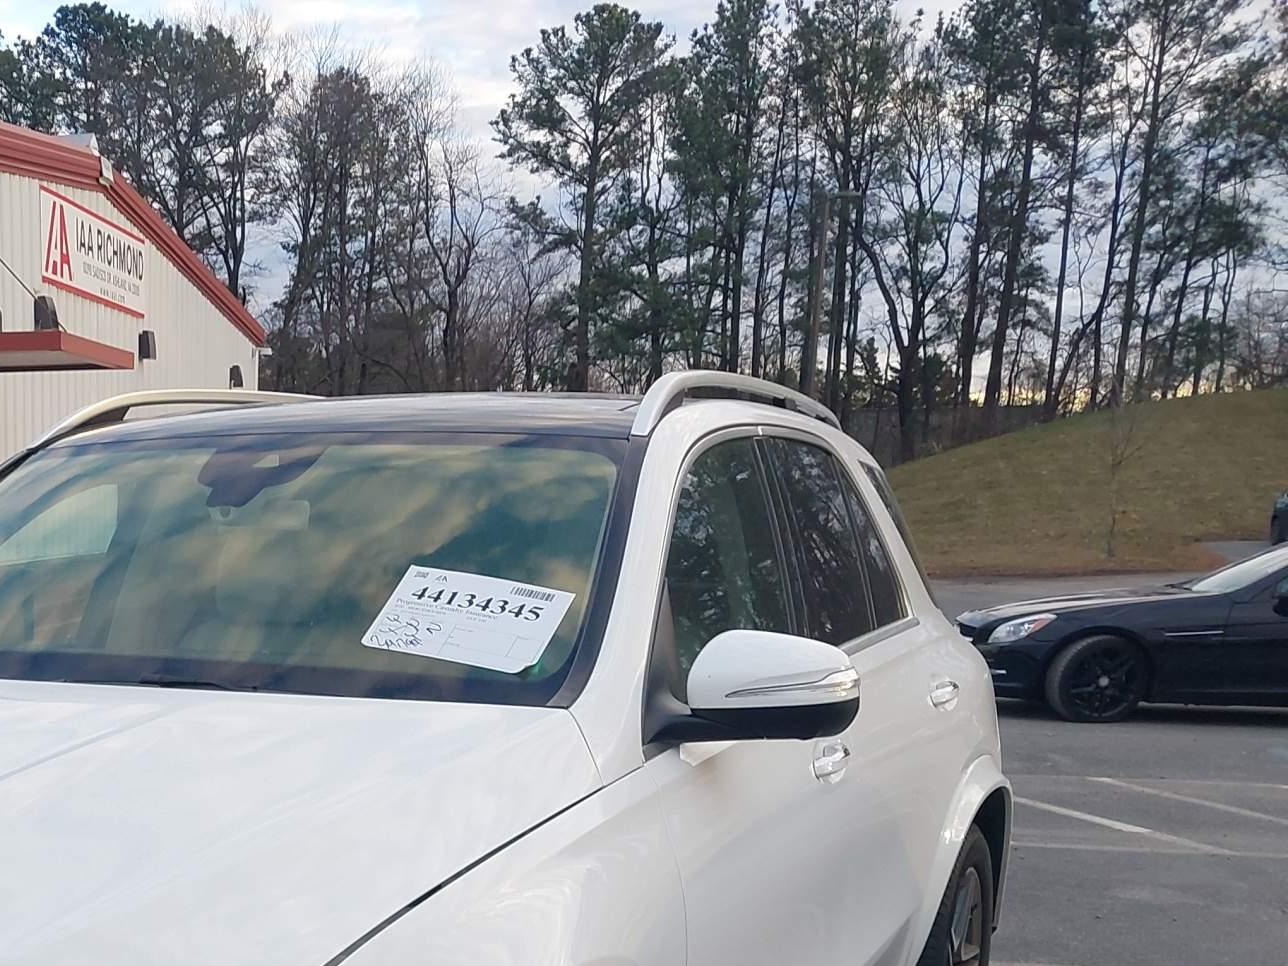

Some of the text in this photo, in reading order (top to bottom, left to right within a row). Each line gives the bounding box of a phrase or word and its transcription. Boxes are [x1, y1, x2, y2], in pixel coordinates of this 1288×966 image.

[75, 216, 95, 259] IAA
[96, 228, 144, 282] RICHMOND
[411, 585, 546, 623] 44134345
